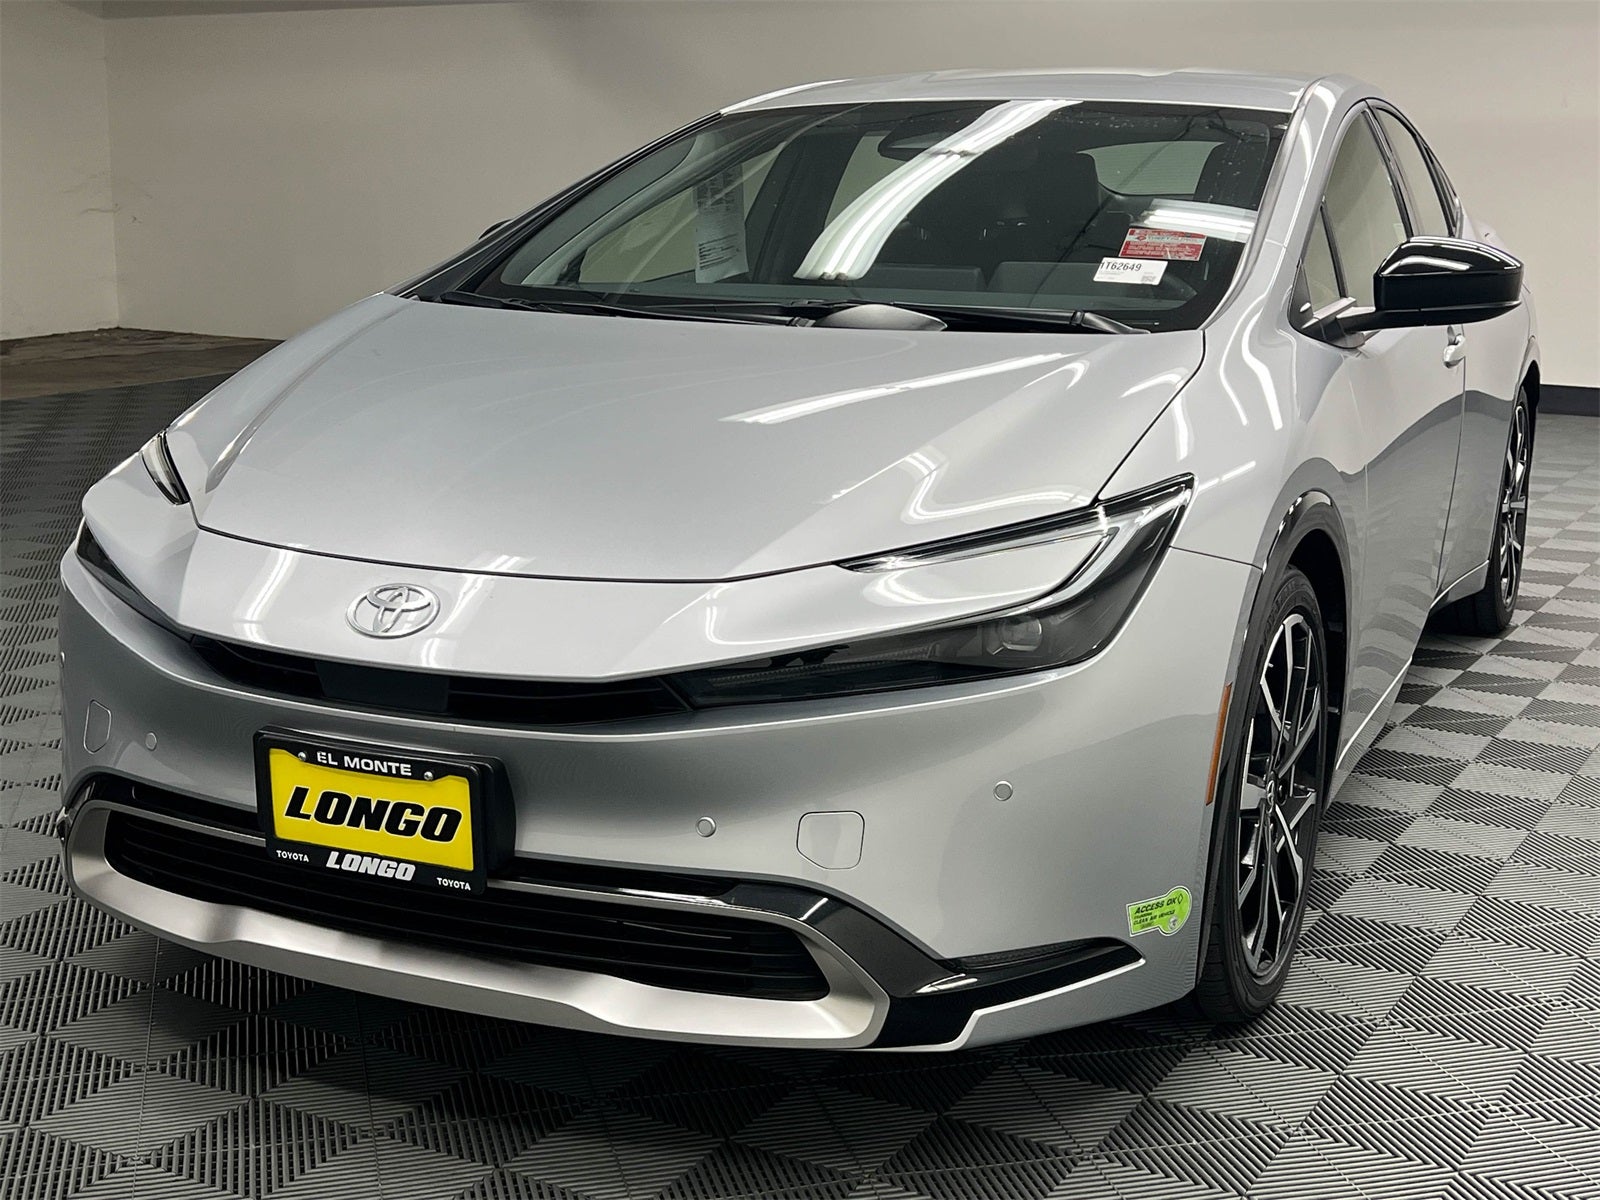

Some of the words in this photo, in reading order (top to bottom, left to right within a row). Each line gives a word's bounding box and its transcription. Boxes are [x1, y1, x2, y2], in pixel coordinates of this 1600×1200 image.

[317, 751, 338, 765] EL
[344, 755, 412, 776] MONTE
[284, 785, 463, 843] LONGO
[276, 850, 309, 862] TOYOTA
[326, 851, 416, 881] LONGO
[437, 877, 471, 891] TOYOTA
[1134, 900, 1165, 915] ACCESS
[1166, 896, 1177, 906] OK
[1133, 917, 1149, 925] CLEAN
